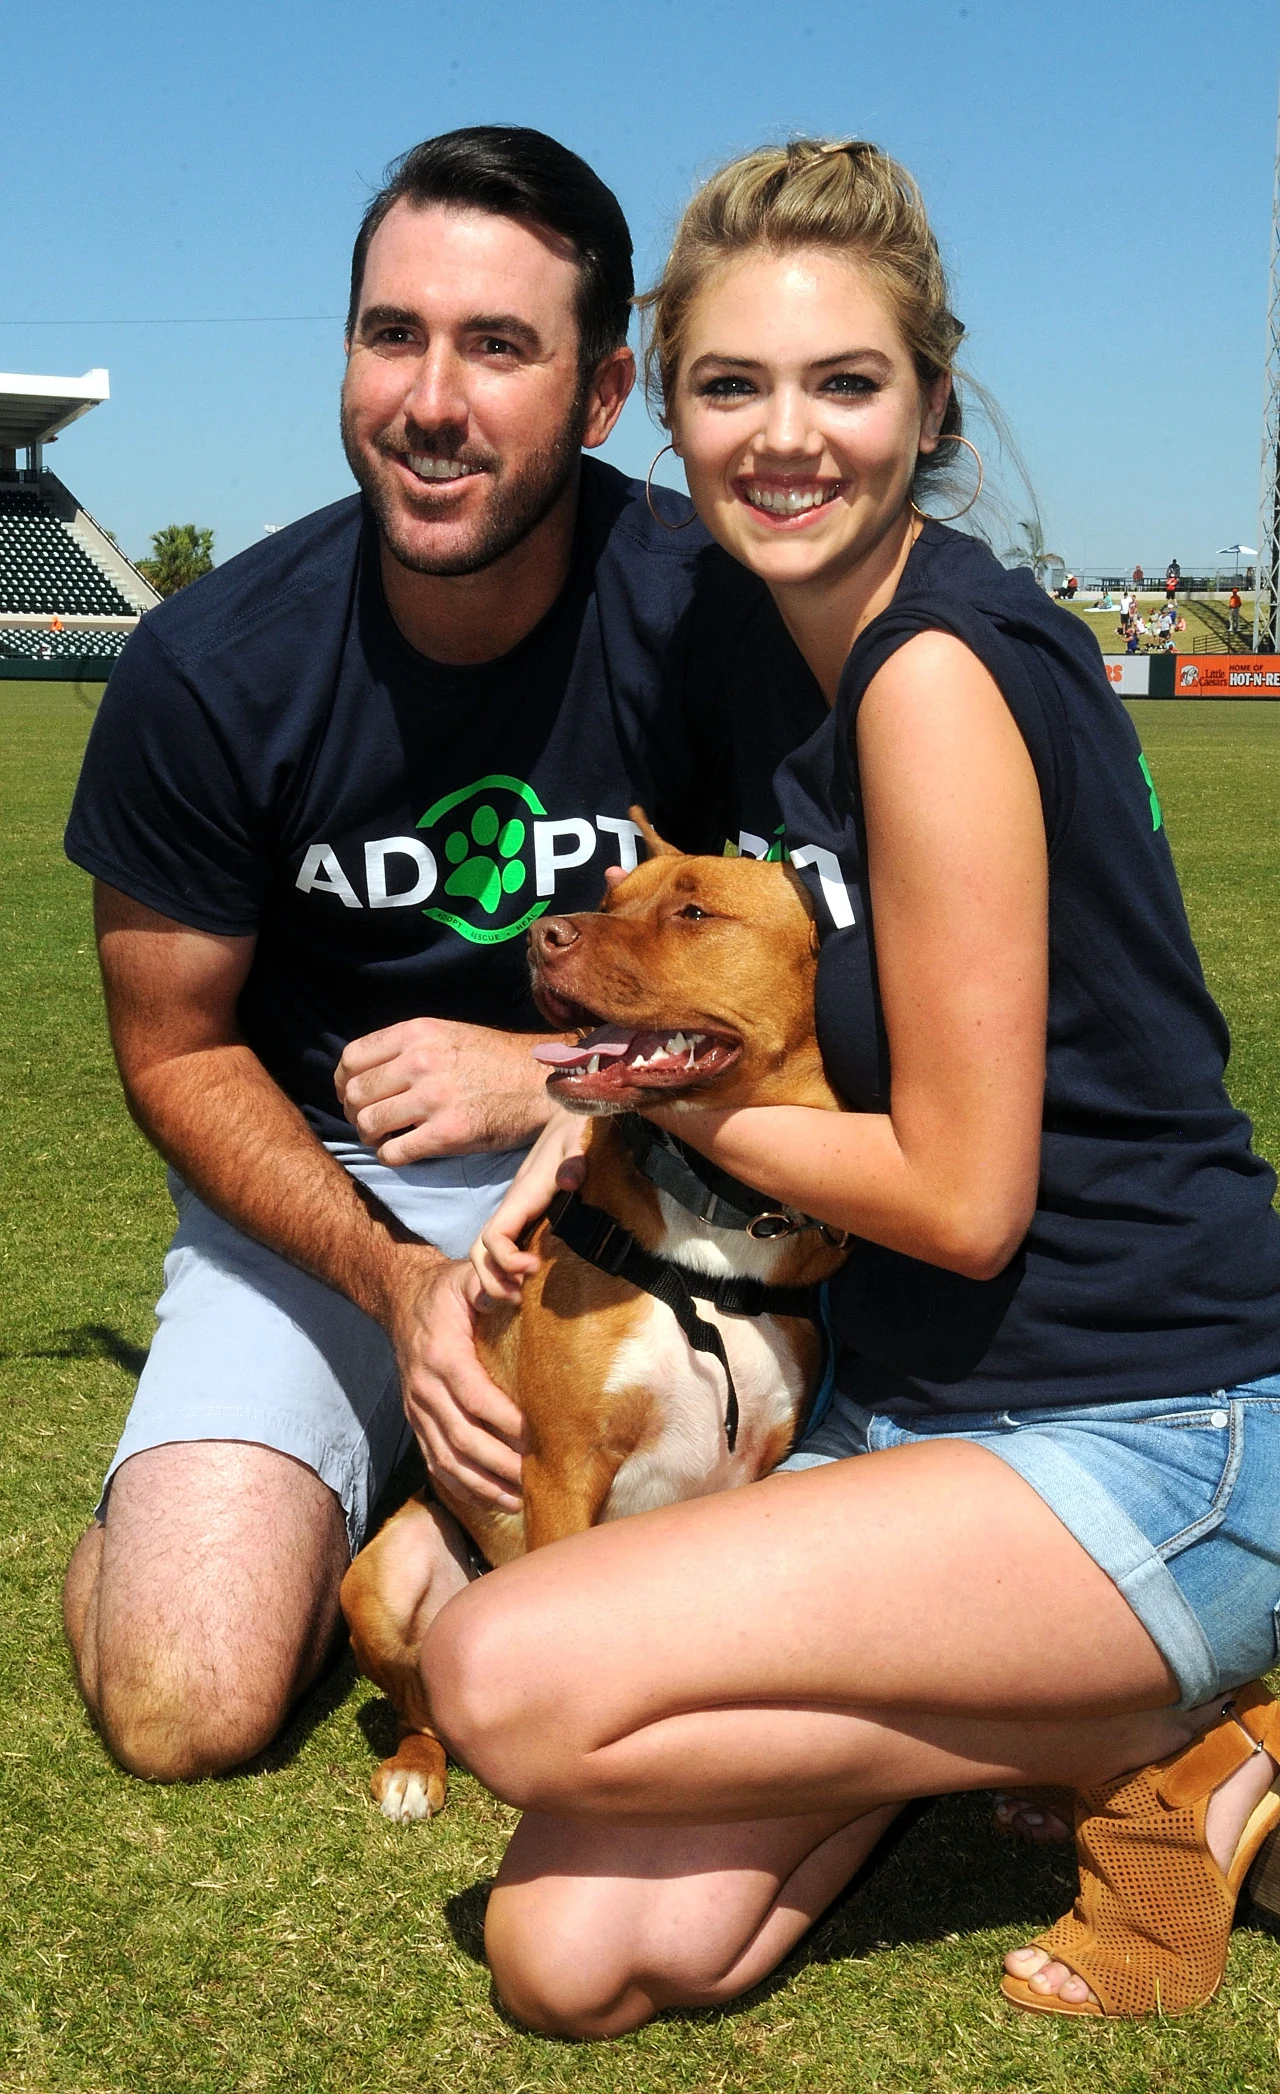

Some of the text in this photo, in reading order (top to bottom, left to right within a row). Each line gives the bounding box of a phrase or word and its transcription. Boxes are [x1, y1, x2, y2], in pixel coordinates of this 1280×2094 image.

[1205, 669, 1225, 679] Little
[1199, 677, 1227, 687] Caesars
[436, 912, 538, 941] ADOPT RESCUE HEAL
